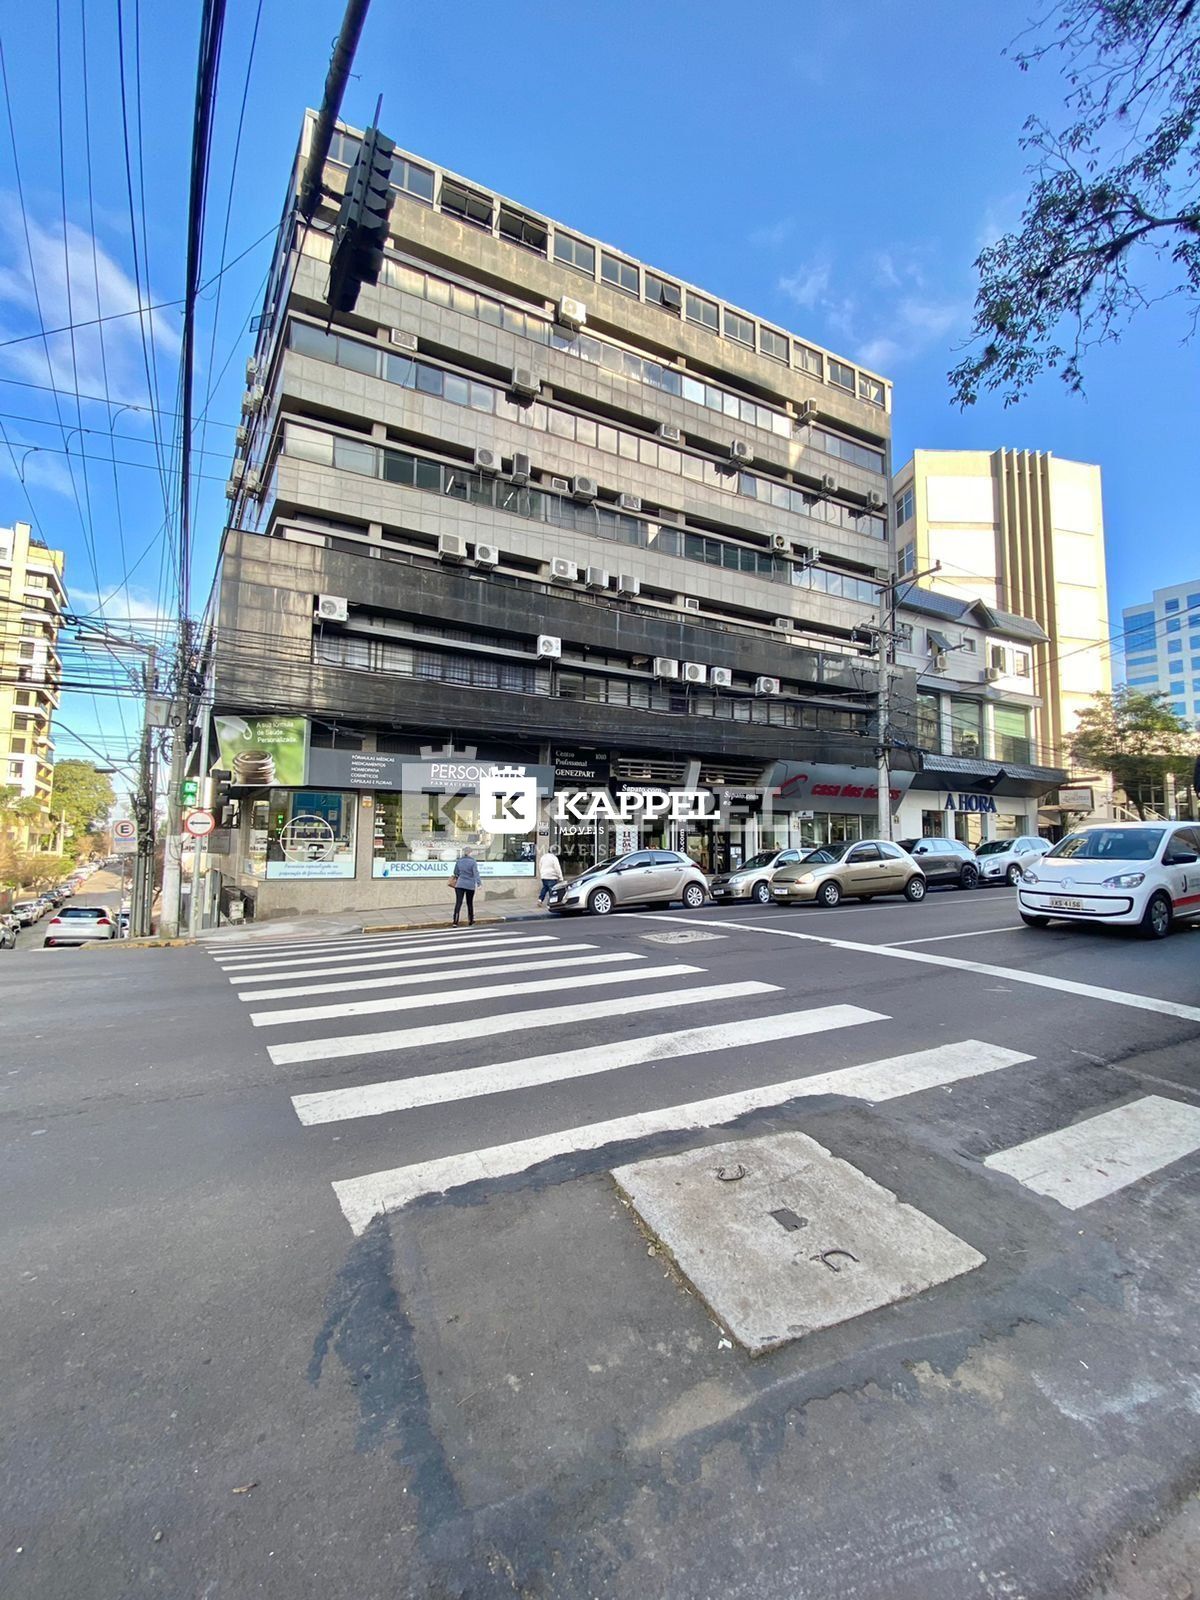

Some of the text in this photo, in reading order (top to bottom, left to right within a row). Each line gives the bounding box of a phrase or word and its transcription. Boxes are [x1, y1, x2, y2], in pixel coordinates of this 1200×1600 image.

[555, 768, 596, 778] GENEZPART
[811, 783, 841, 797] casa
[841, 784, 865, 798] dos
[944, 793, 997, 813] A HORA
[120, 824, 130, 834] E
[390, 862, 448, 872] PERSONALLIS
